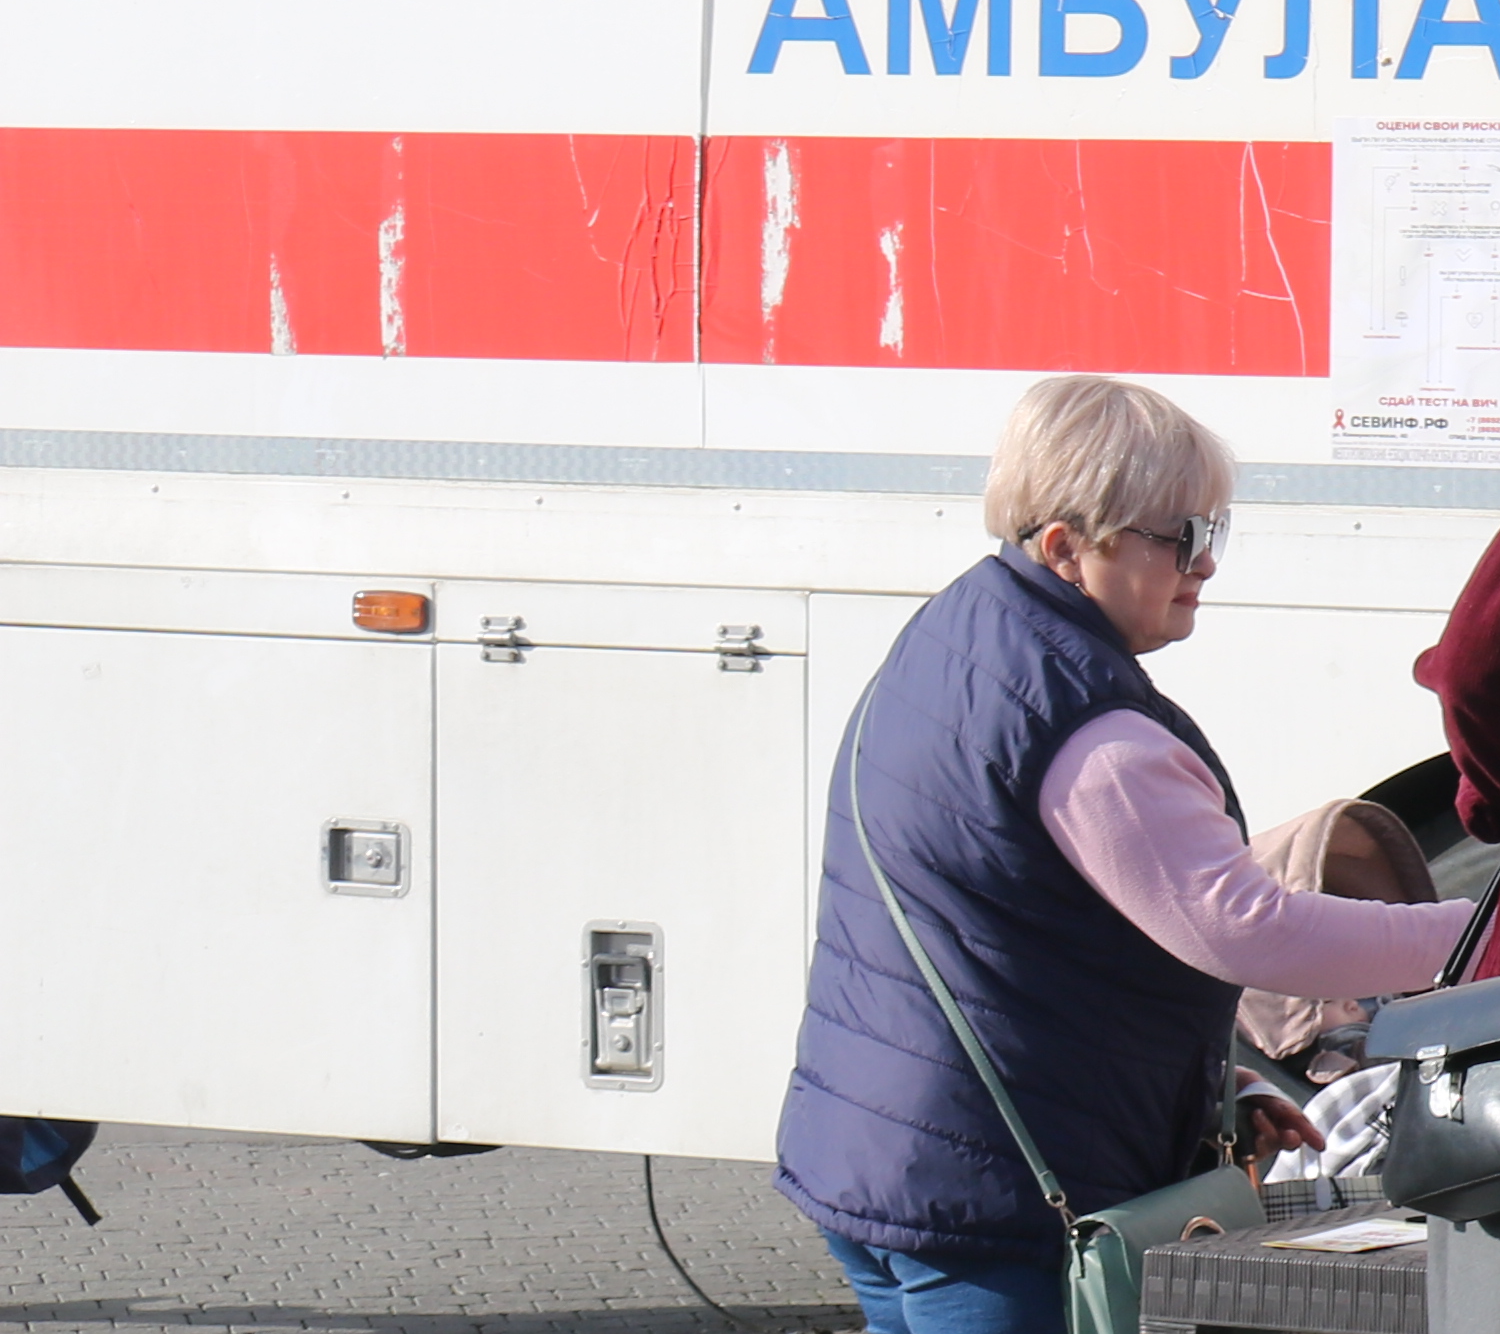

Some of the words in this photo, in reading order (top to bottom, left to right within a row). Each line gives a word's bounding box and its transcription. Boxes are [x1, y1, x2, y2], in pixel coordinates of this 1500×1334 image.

[1376, 122, 1421, 132] ОЦЕНИ
[1423, 122, 1459, 131] СВОИ
[1378, 395, 1415, 407] СДАЙ
[1418, 397, 1448, 407] ТЕСТ
[1451, 398, 1469, 408] НА
[1472, 398, 1499, 408] ВИЧ
[1350, 415, 1449, 430] СЕВИНФ.РФ
